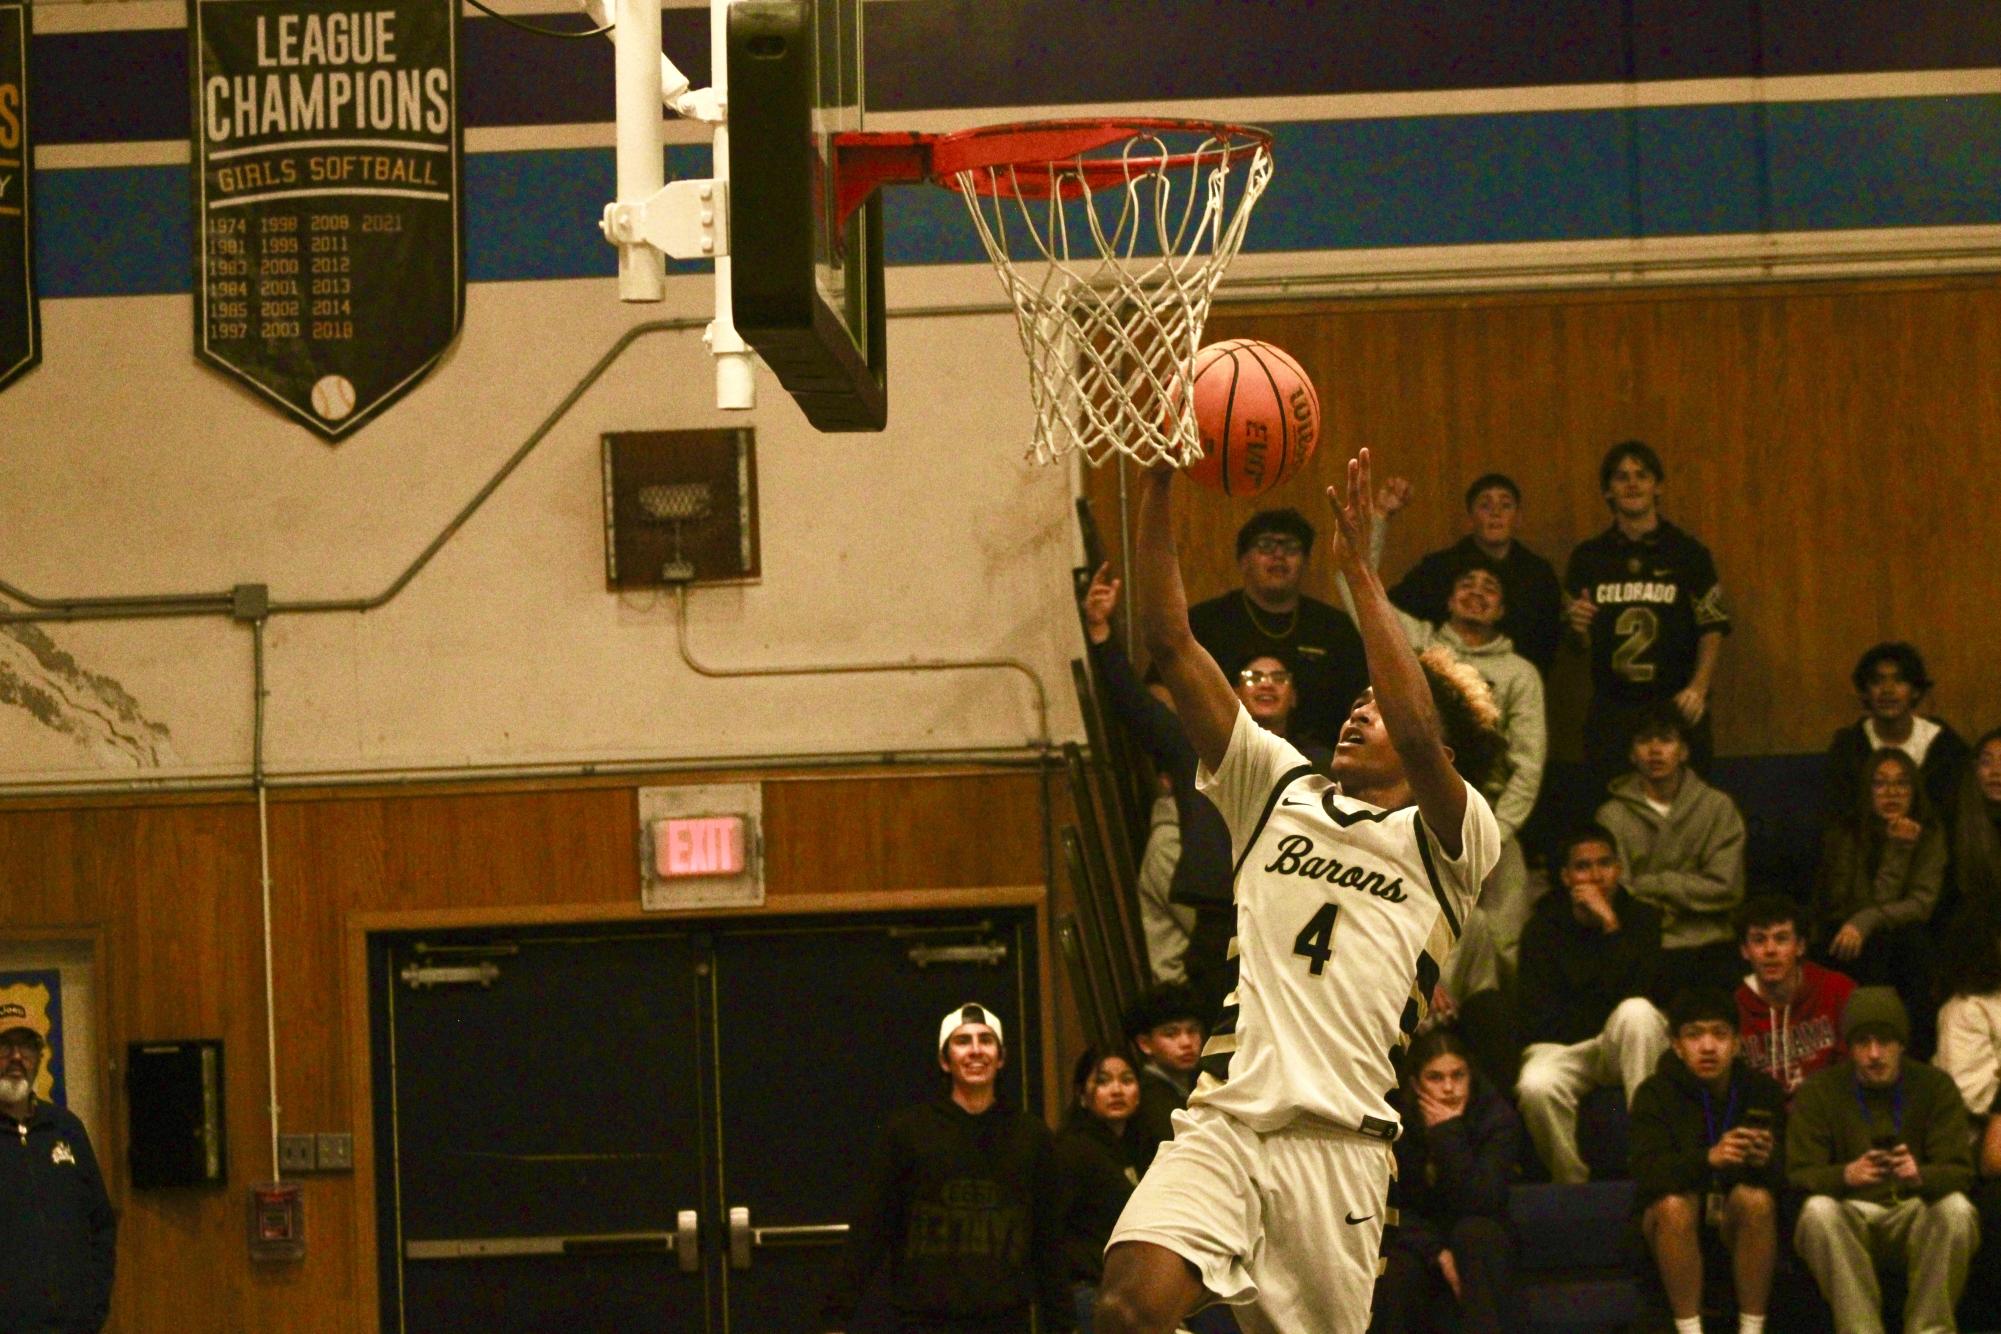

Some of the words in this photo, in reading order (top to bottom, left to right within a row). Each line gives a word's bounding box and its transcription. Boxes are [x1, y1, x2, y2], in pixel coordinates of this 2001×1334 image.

[256, 11, 397, 67] LEAGUE
[206, 67, 449, 142] CHAMPIONS
[218, 159, 297, 193] GIRLS
[309, 156, 438, 186] SOFTBALL
[211, 218, 246, 234] 1974
[262, 217, 298, 232] 1998
[362, 215, 402, 232] 2021
[211, 240, 246, 255] 1981
[262, 238, 298, 254] 1999
[311, 236, 348, 252] 2011
[211, 260, 248, 276] 1983
[311, 256, 350, 273] 2012
[211, 281, 248, 297] 1984
[261, 280, 298, 296] 2001
[312, 278, 350, 295] 2013
[211, 302, 248, 318] 1985
[261, 301, 300, 317] 2002
[312, 299, 351, 316] 2014
[211, 323, 247, 339] 1997
[261, 322, 300, 338] 2003
[313, 321, 353, 339] 2018
[1596, 582, 1677, 604] COLORADO
[1612, 607, 1658, 681] 2
[668, 817, 734, 873] EXIT
[1264, 834, 1408, 903] Barons
[1292, 901, 1339, 976] 4
